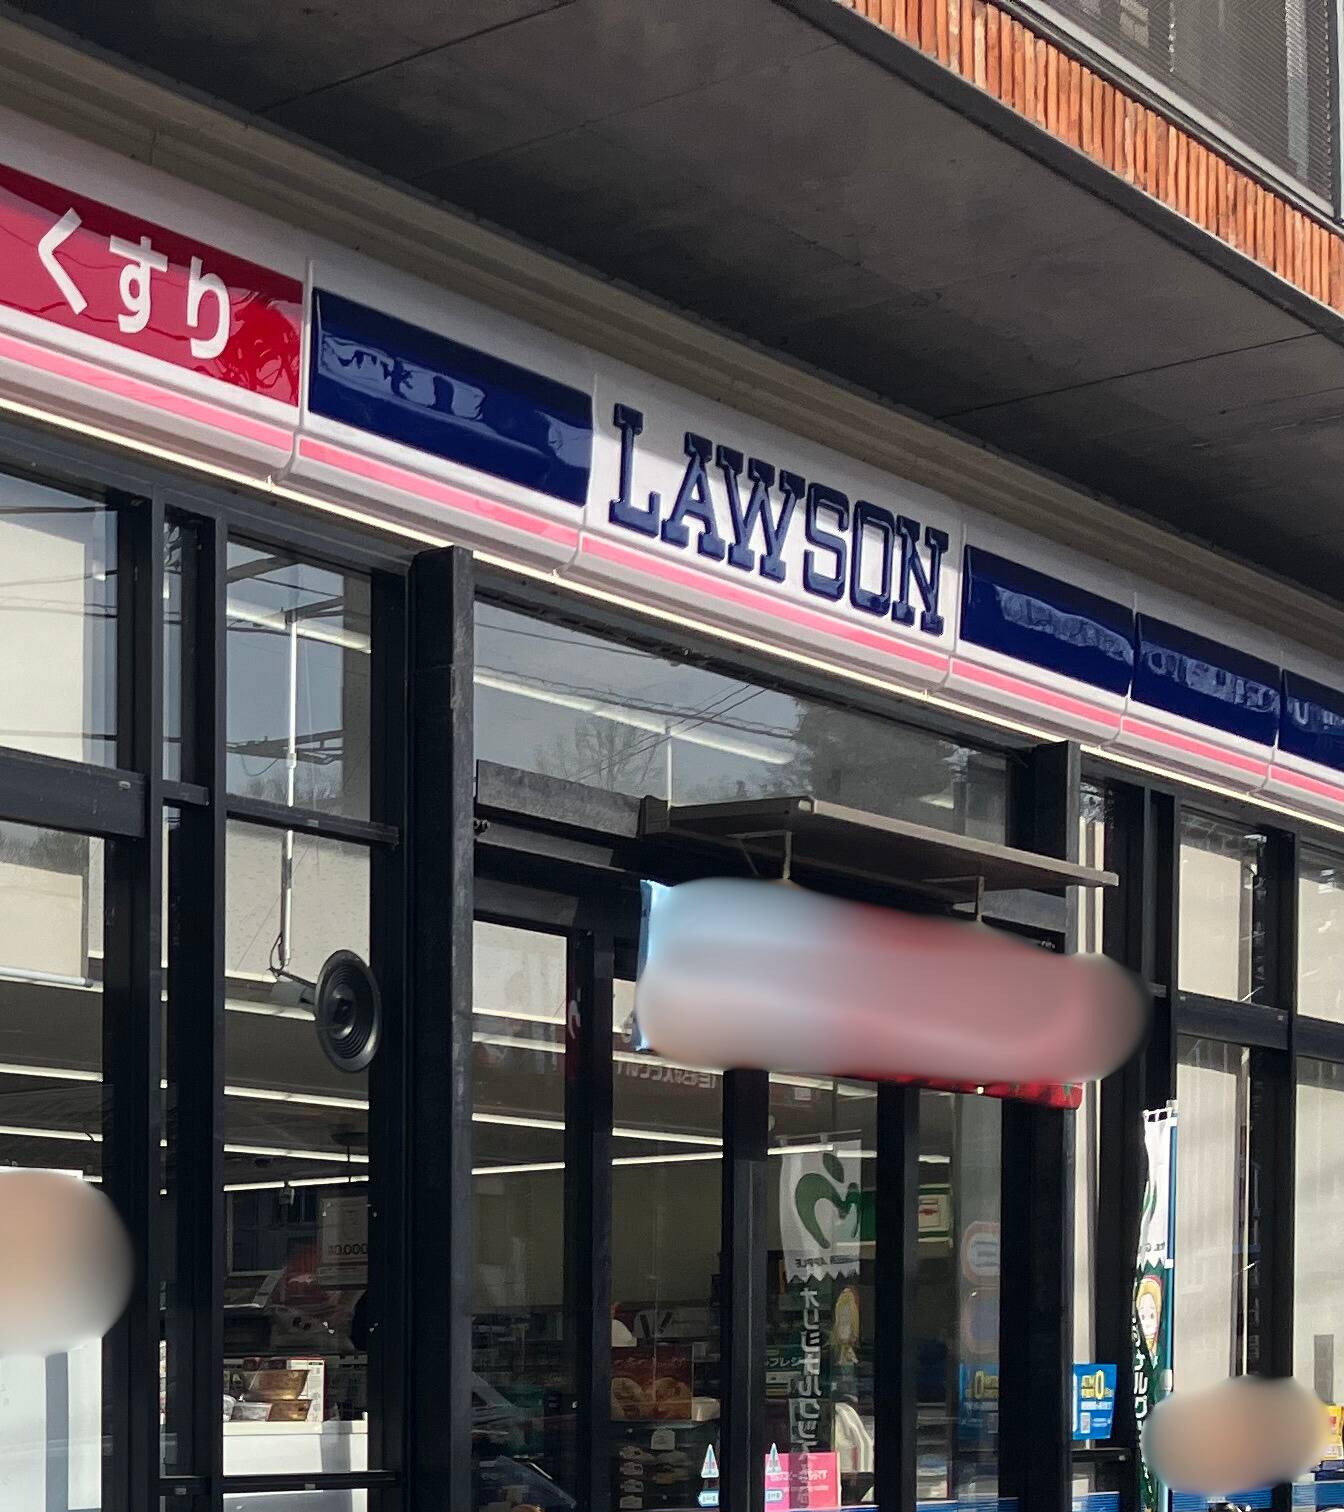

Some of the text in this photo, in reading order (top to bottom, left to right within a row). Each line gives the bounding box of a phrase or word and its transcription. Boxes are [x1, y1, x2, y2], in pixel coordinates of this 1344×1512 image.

[36, 206, 232, 360] くすり
[606, 403, 949, 636] LAWSON
